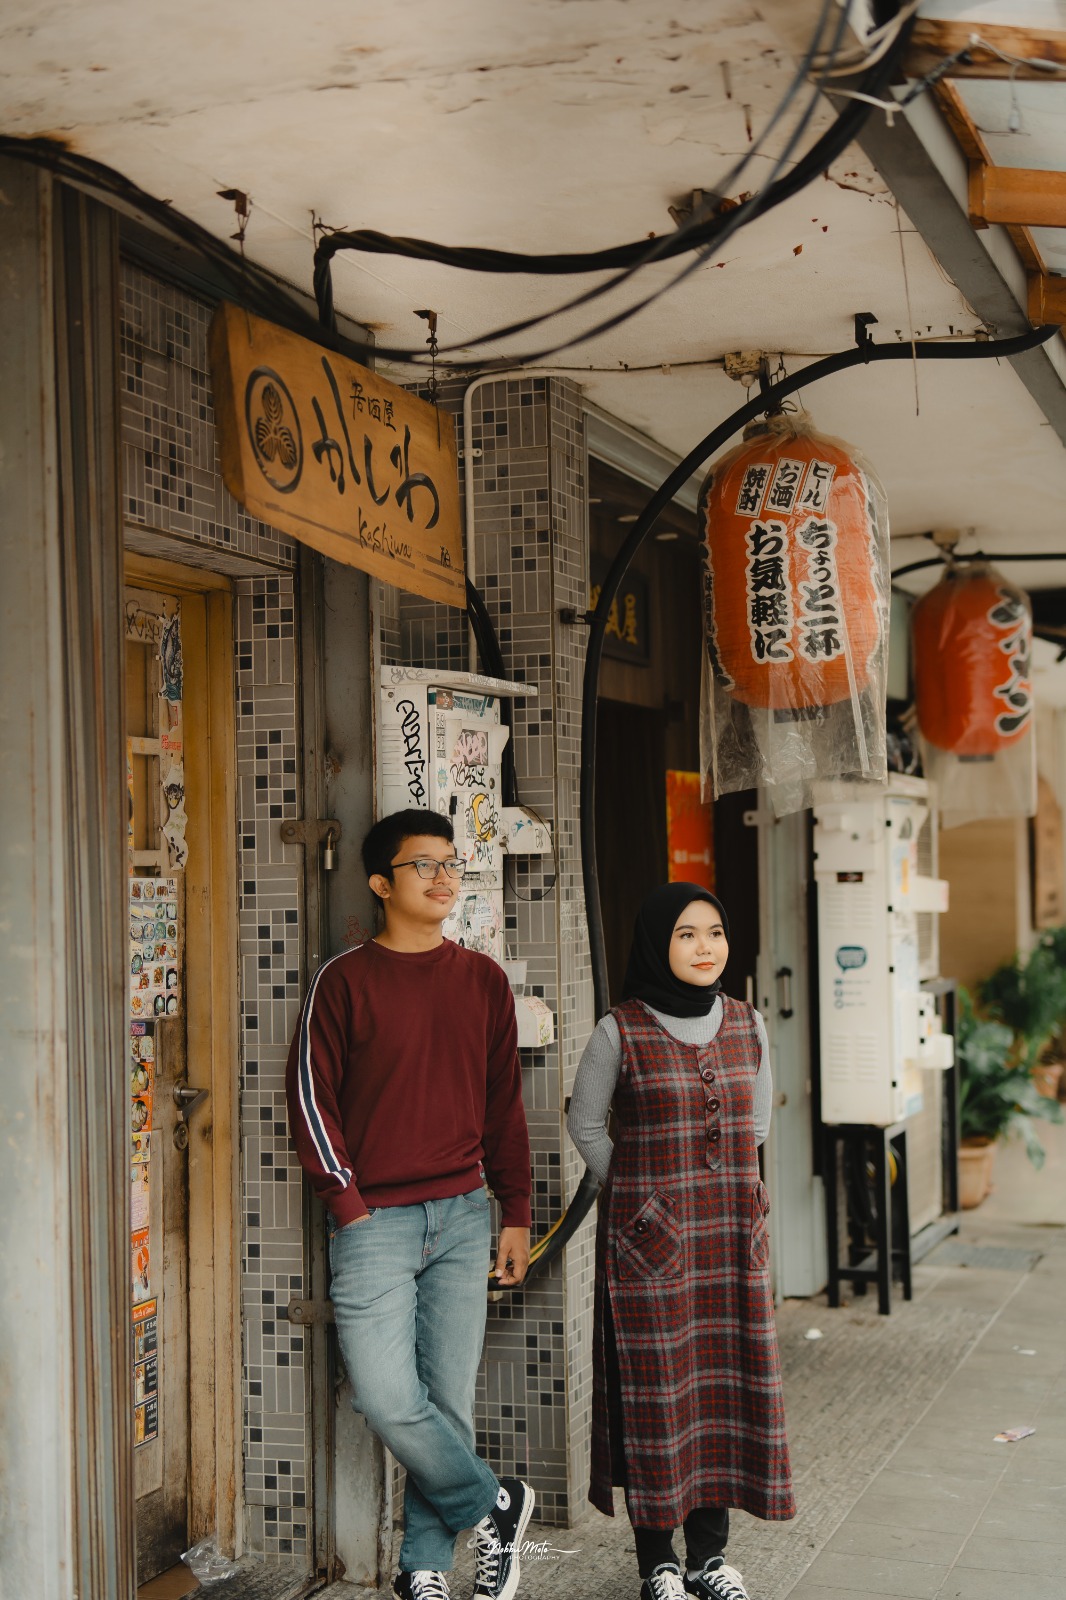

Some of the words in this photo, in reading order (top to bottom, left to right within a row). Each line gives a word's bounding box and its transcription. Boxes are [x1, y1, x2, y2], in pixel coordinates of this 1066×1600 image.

[349, 381, 397, 432] 居酒屋
[311, 355, 440, 530] かしわ
[738, 467, 767, 513] 焼酎
[770, 462, 800, 509] お酒
[801, 461, 832, 508] ビール
[748, 524, 789, 659] お気軽に
[799, 520, 841, 659] ちょっと一杯
